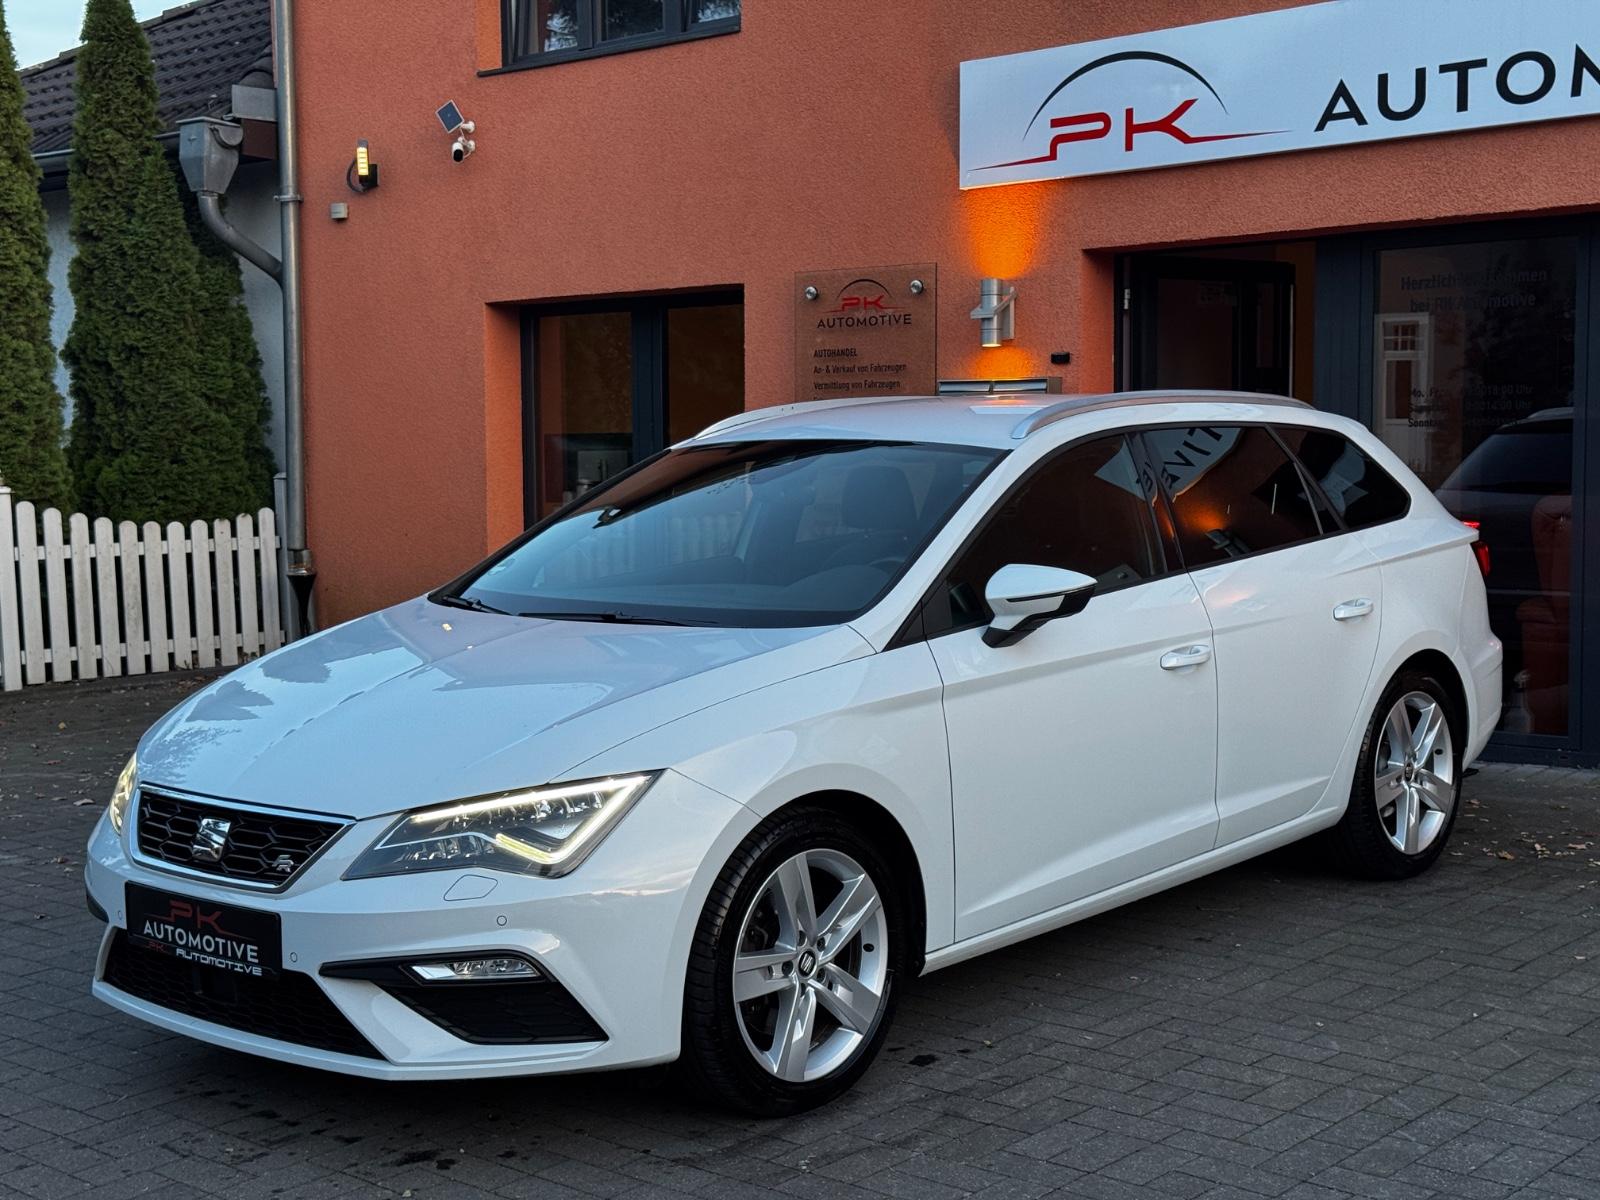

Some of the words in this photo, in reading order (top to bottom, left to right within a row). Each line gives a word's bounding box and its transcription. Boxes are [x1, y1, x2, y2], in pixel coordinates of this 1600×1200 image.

[816, 313, 912, 329] AUTOMOTIVE
[813, 347, 858, 358] AUTOHANDEL
[832, 364, 856, 374] Verkauf
[857, 365, 870, 373] von
[870, 363, 907, 374] Fahrzeugen
[813, 380, 850, 391] Vermittlung
[851, 381, 863, 389] von
[864, 379, 901, 390] Fahrzeugen
[143, 919, 260, 964] AUTOMOTIVE
[175, 947, 263, 977] AUTOMOTIVE
